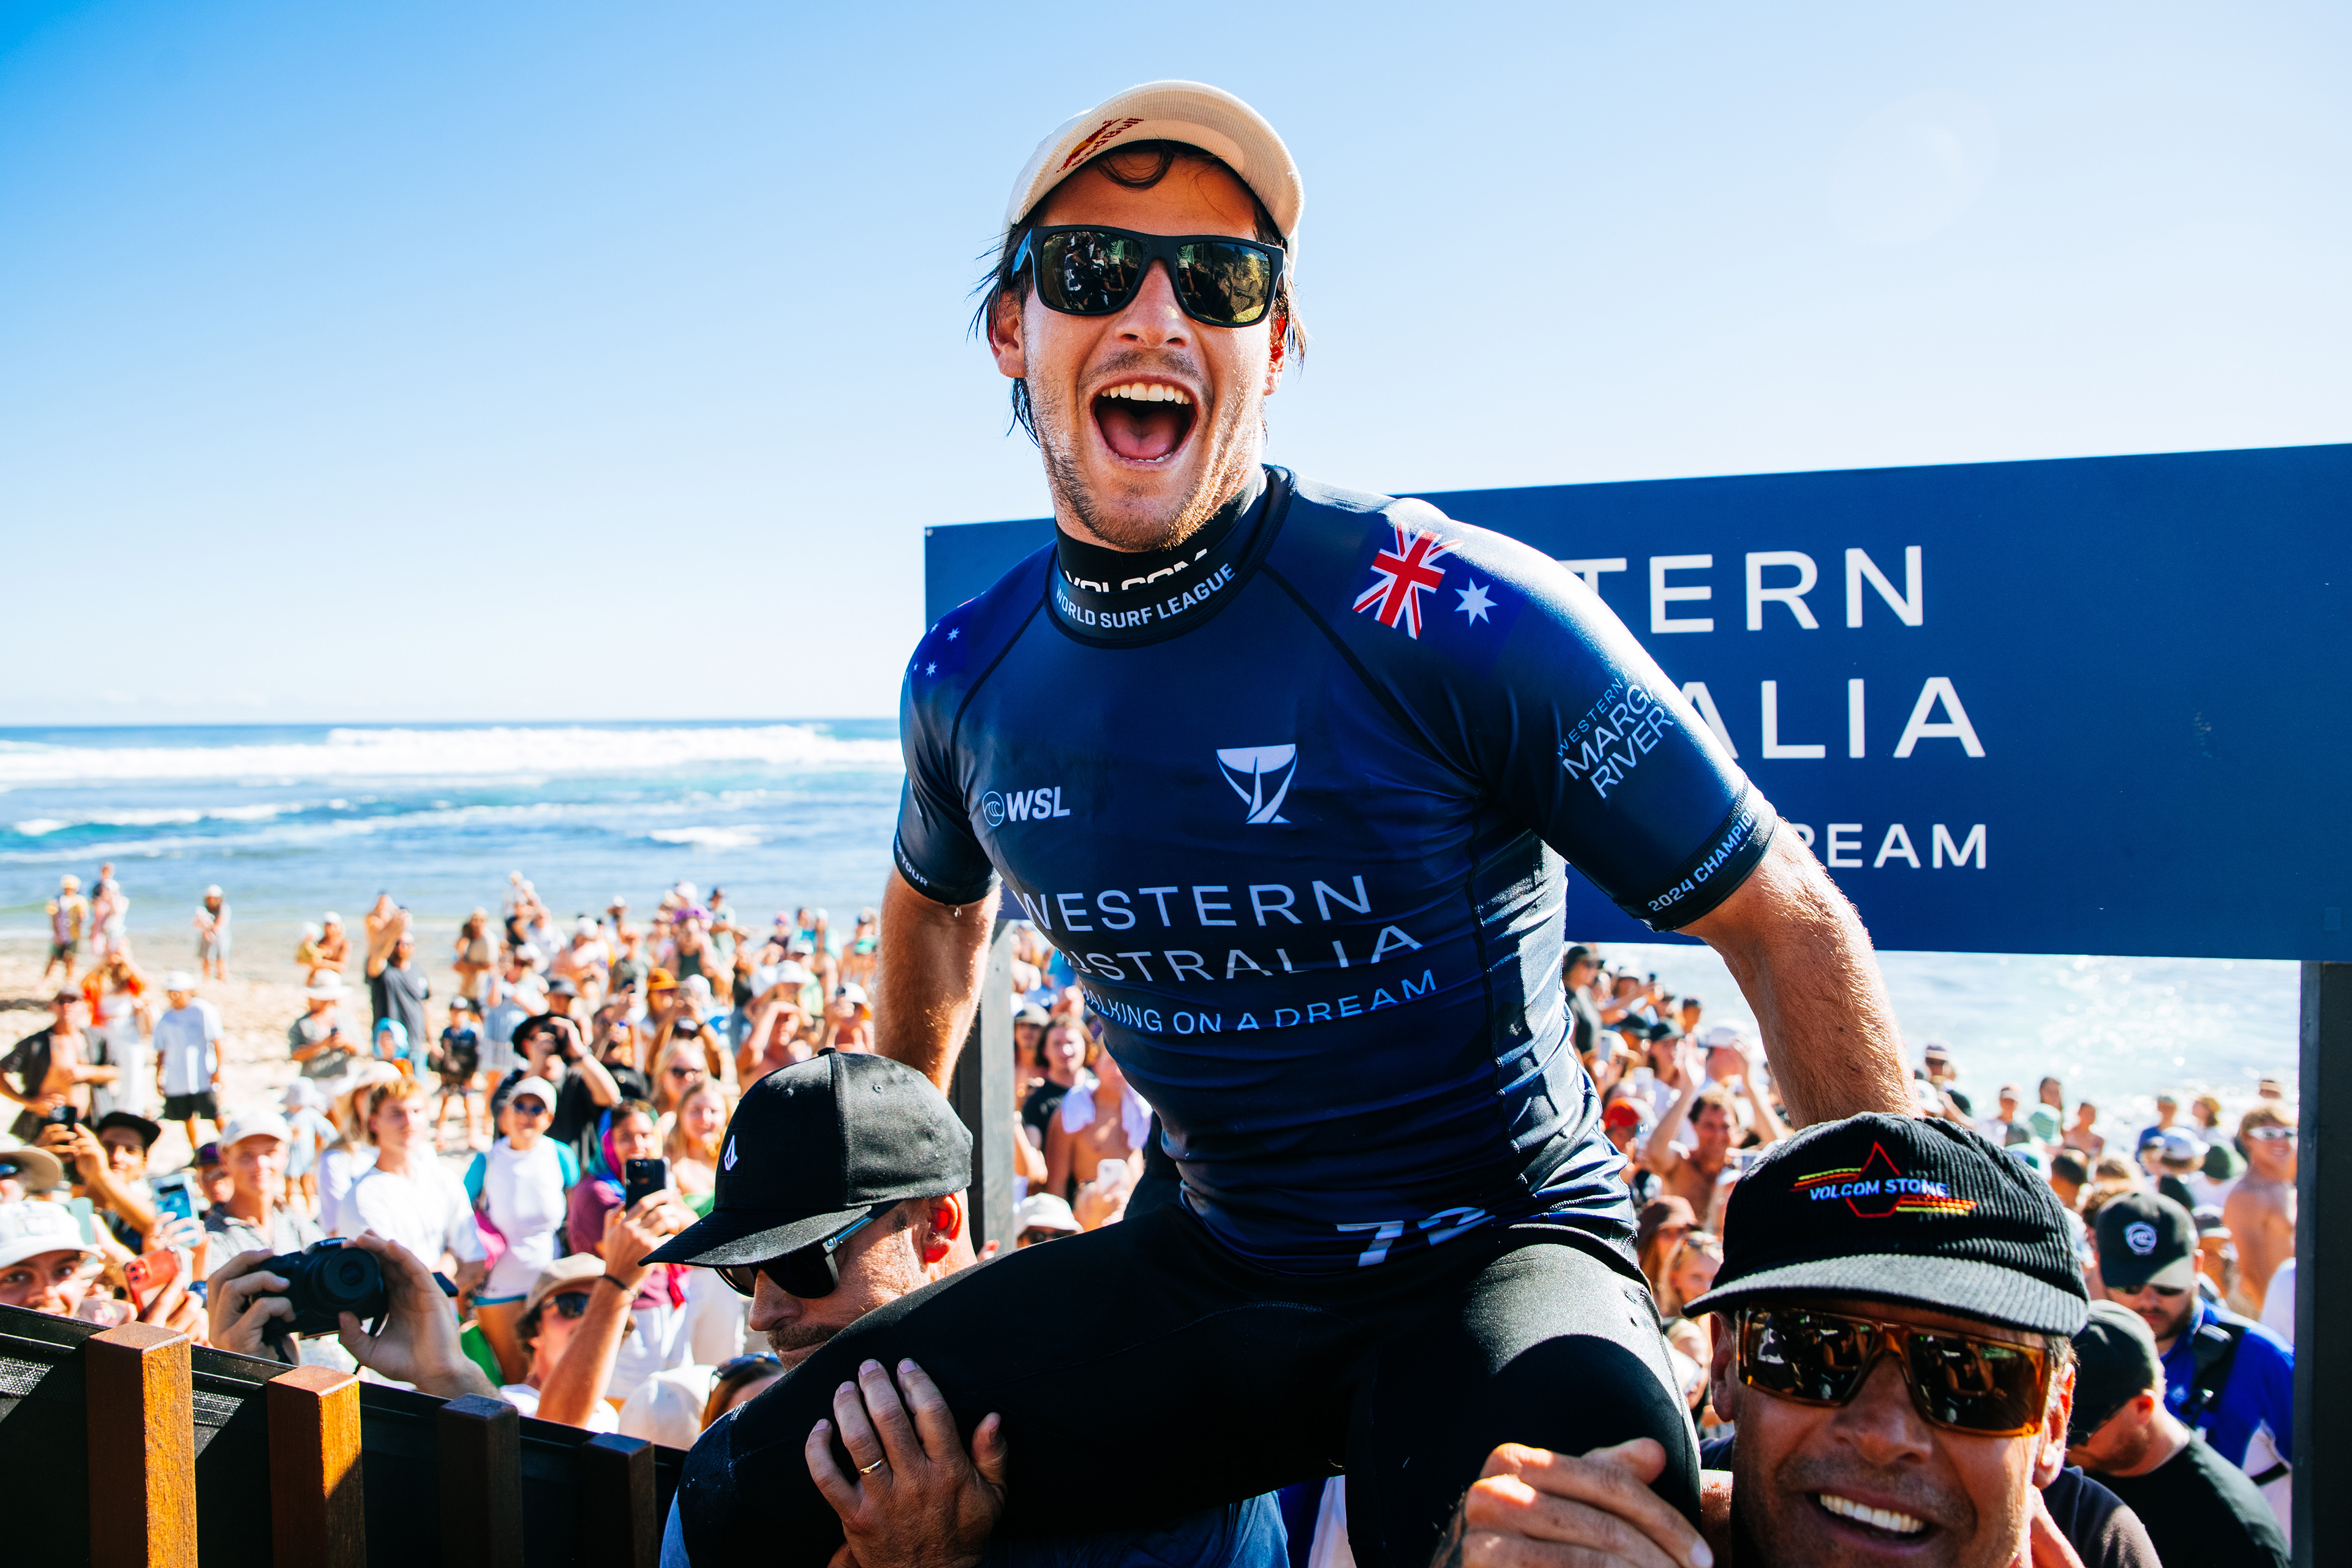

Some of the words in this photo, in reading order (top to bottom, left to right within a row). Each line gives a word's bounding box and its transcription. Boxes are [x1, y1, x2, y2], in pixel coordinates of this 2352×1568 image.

[1055, 582, 1096, 626] WORLD
[1100, 606, 1152, 628] SURF
[1156, 562, 1236, 620] LEAGUE
[1557, 677, 1623, 757] WESTERN
[1589, 706, 1675, 799] RIVER
[1006, 786, 1071, 822] WSL
[902, 854, 929, 886] TOUR
[1648, 878, 1695, 912] 2024
[1012, 875, 1372, 932] WESTERN
[1173, 1011, 1221, 1034] ON
[1237, 1012, 1260, 1031] A
[1274, 969, 1437, 1027] DREAM
[1810, 1179, 1880, 1200] VOLCOM
[1885, 1178, 1950, 1197] STONE
